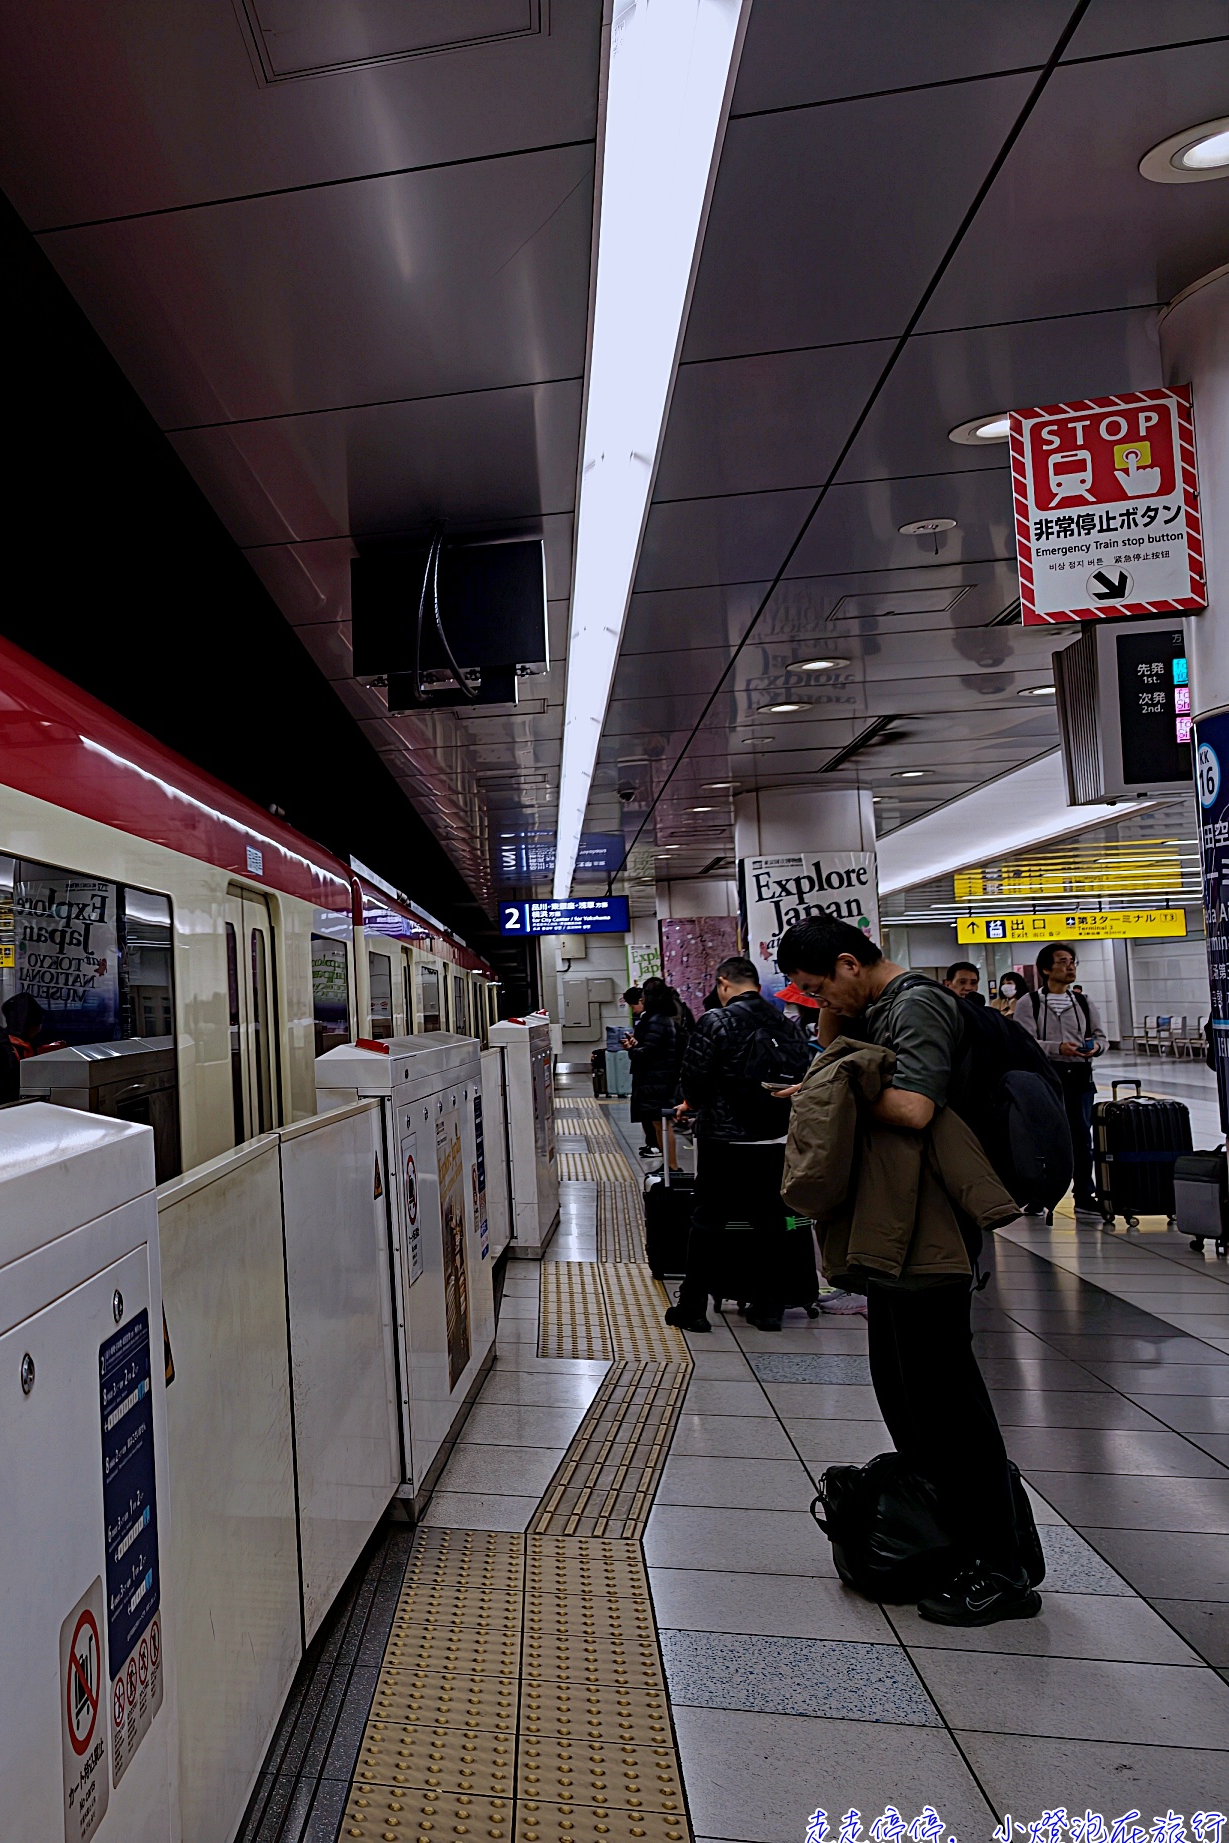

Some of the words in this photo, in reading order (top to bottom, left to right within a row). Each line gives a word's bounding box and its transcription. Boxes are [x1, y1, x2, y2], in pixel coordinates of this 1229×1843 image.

[1041, 411, 1159, 450] STOP
[1034, 504, 1182, 542] 非常停止ボタン
[1035, 543, 1091, 557] Emergency
[1094, 539, 1119, 550] Train
[1122, 536, 1145, 548] stop
[1148, 532, 1184, 544] button
[1137, 662, 1165, 675] 先発
[1143, 676, 1160, 684] 1st.
[1138, 692, 1166, 704] 次発
[1142, 704, 1164, 713] 2nd.
[1199, 750, 1209, 765] KK
[1199, 766, 1215, 796] 16
[752, 861, 869, 906] Explore
[504, 908, 521, 929] 2
[1011, 918, 1046, 930] 出口
[1077, 913, 1157, 925] 第3ターミナル
